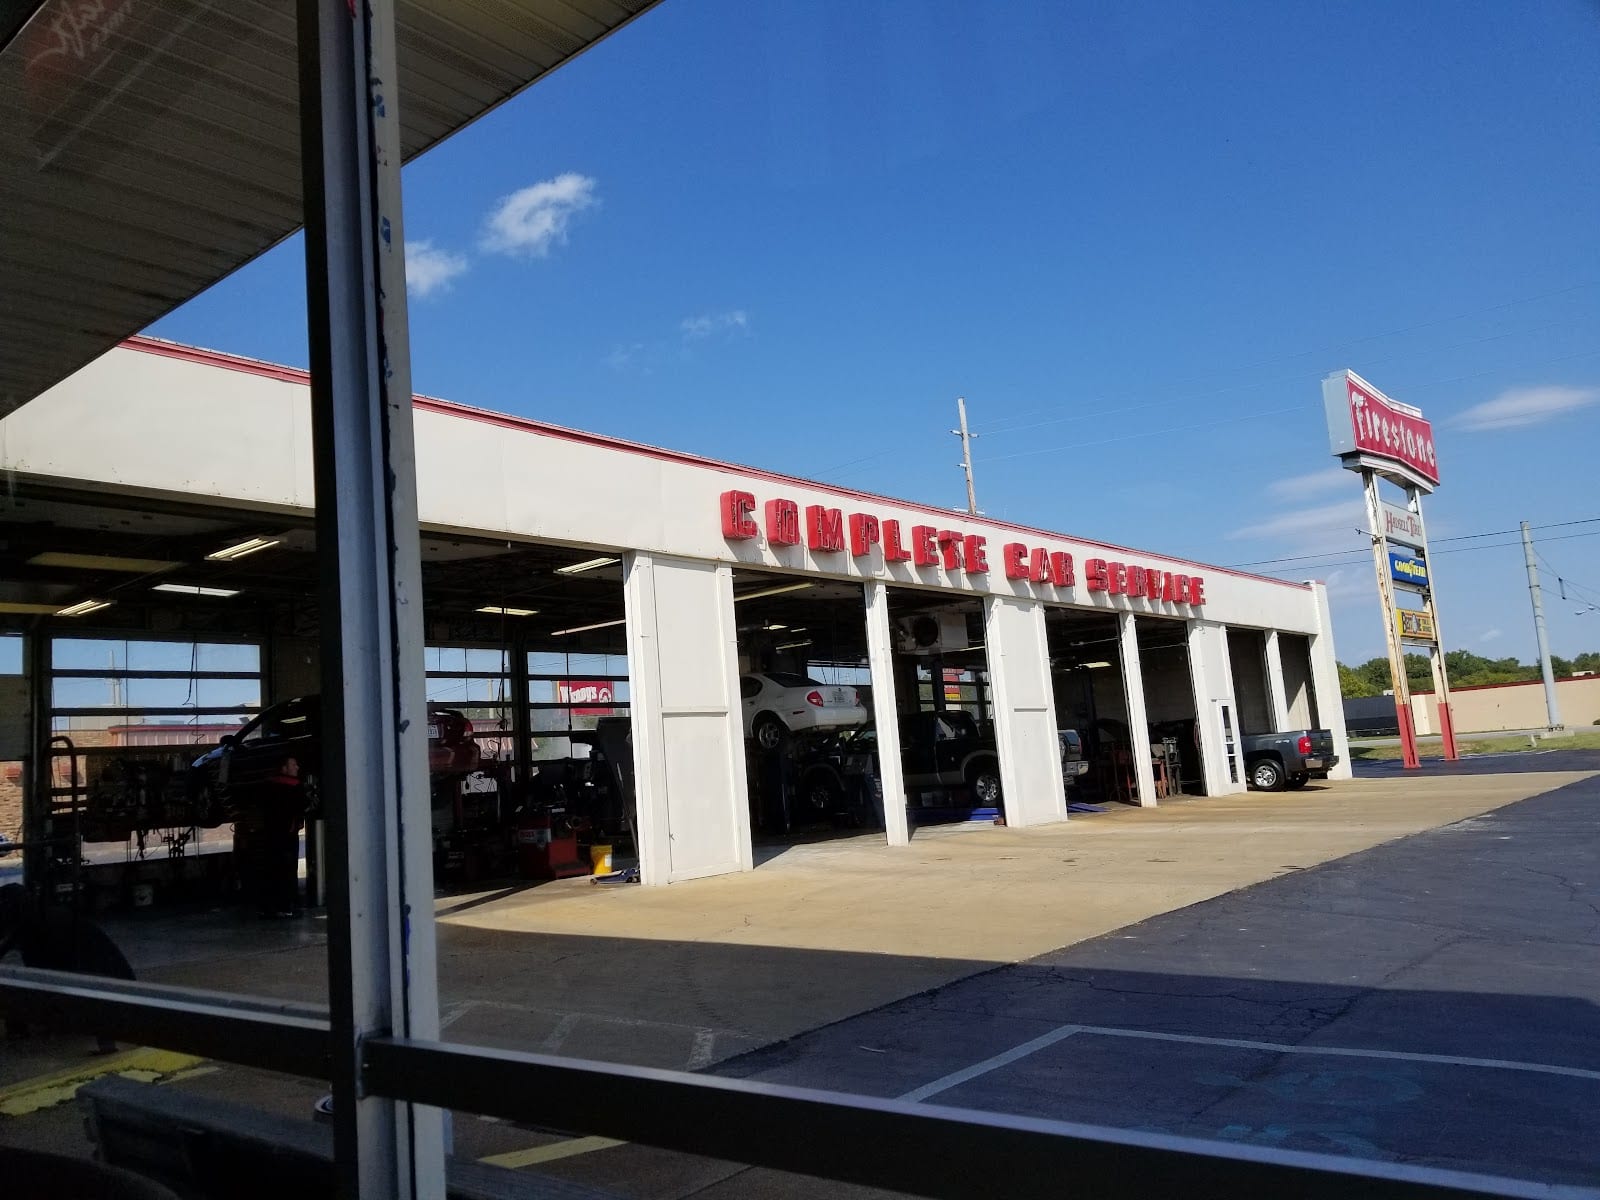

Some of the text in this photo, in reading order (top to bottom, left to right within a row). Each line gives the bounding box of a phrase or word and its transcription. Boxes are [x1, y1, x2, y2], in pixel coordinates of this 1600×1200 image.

[1352, 391, 1435, 467] Firestone
[720, 489, 1207, 606] COMPLETE CAR SERVICE
